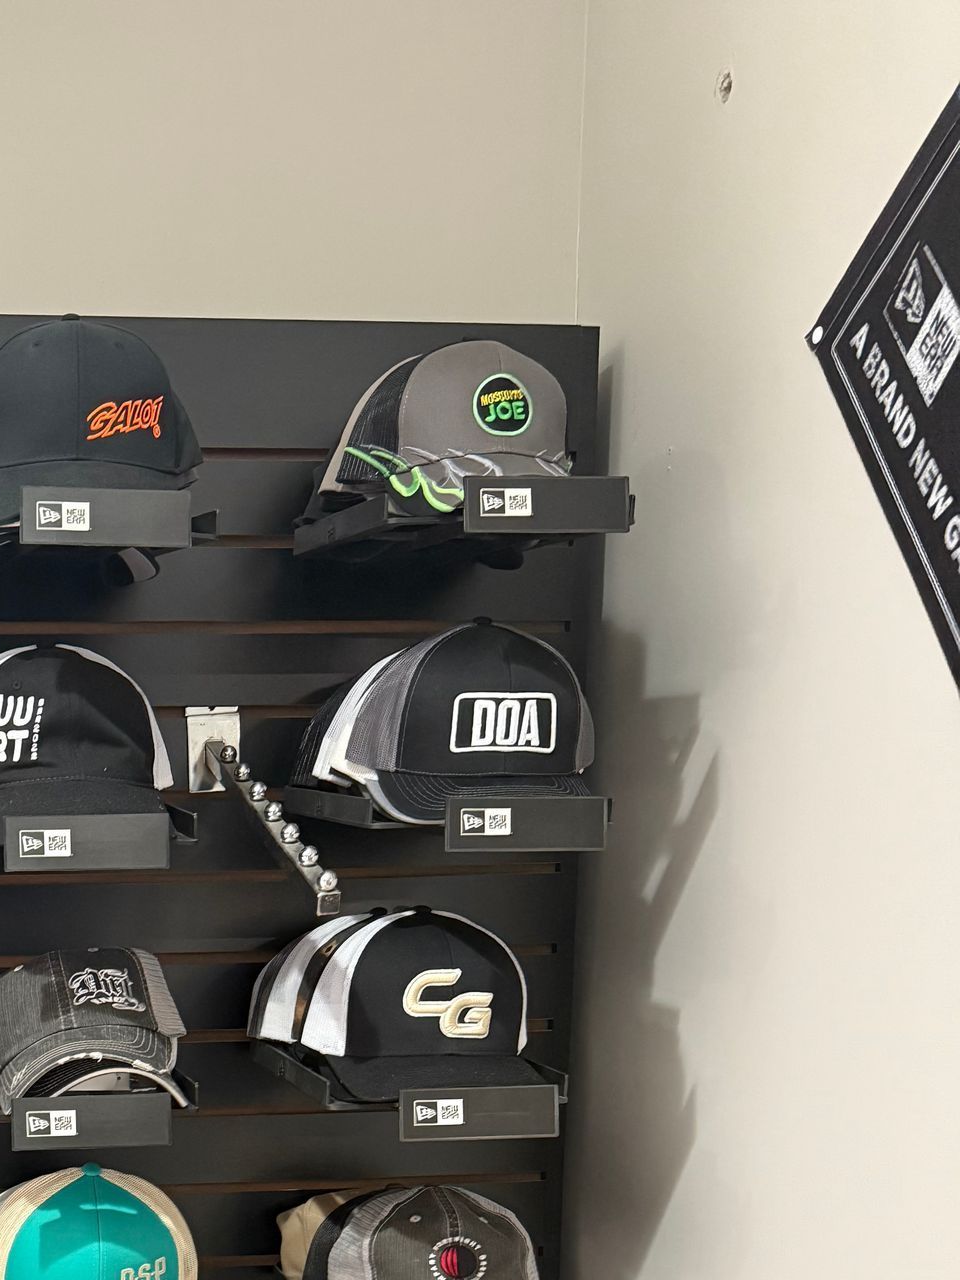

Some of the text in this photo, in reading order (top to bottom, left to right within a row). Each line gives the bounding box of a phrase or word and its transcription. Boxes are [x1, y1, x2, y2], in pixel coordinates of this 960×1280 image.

[484, 401, 527, 423] JOE
[849, 322, 870, 360] A
[862, 342, 917, 449] BRAND
[908, 437, 954, 521] NEW
[508, 493, 528, 503] NEW
[65, 507, 85, 518] NEW
[471, 698, 540, 747] DOA
[486, 813, 507, 822] NEW
[47, 834, 67, 843] NEW
[47, 843, 67, 851] ERA
[439, 1104, 459, 1112] NEW
[53, 1114, 72, 1123] NEW
[439, 1112, 459, 1120] ERA
[53, 1123, 72, 1131] ERA
